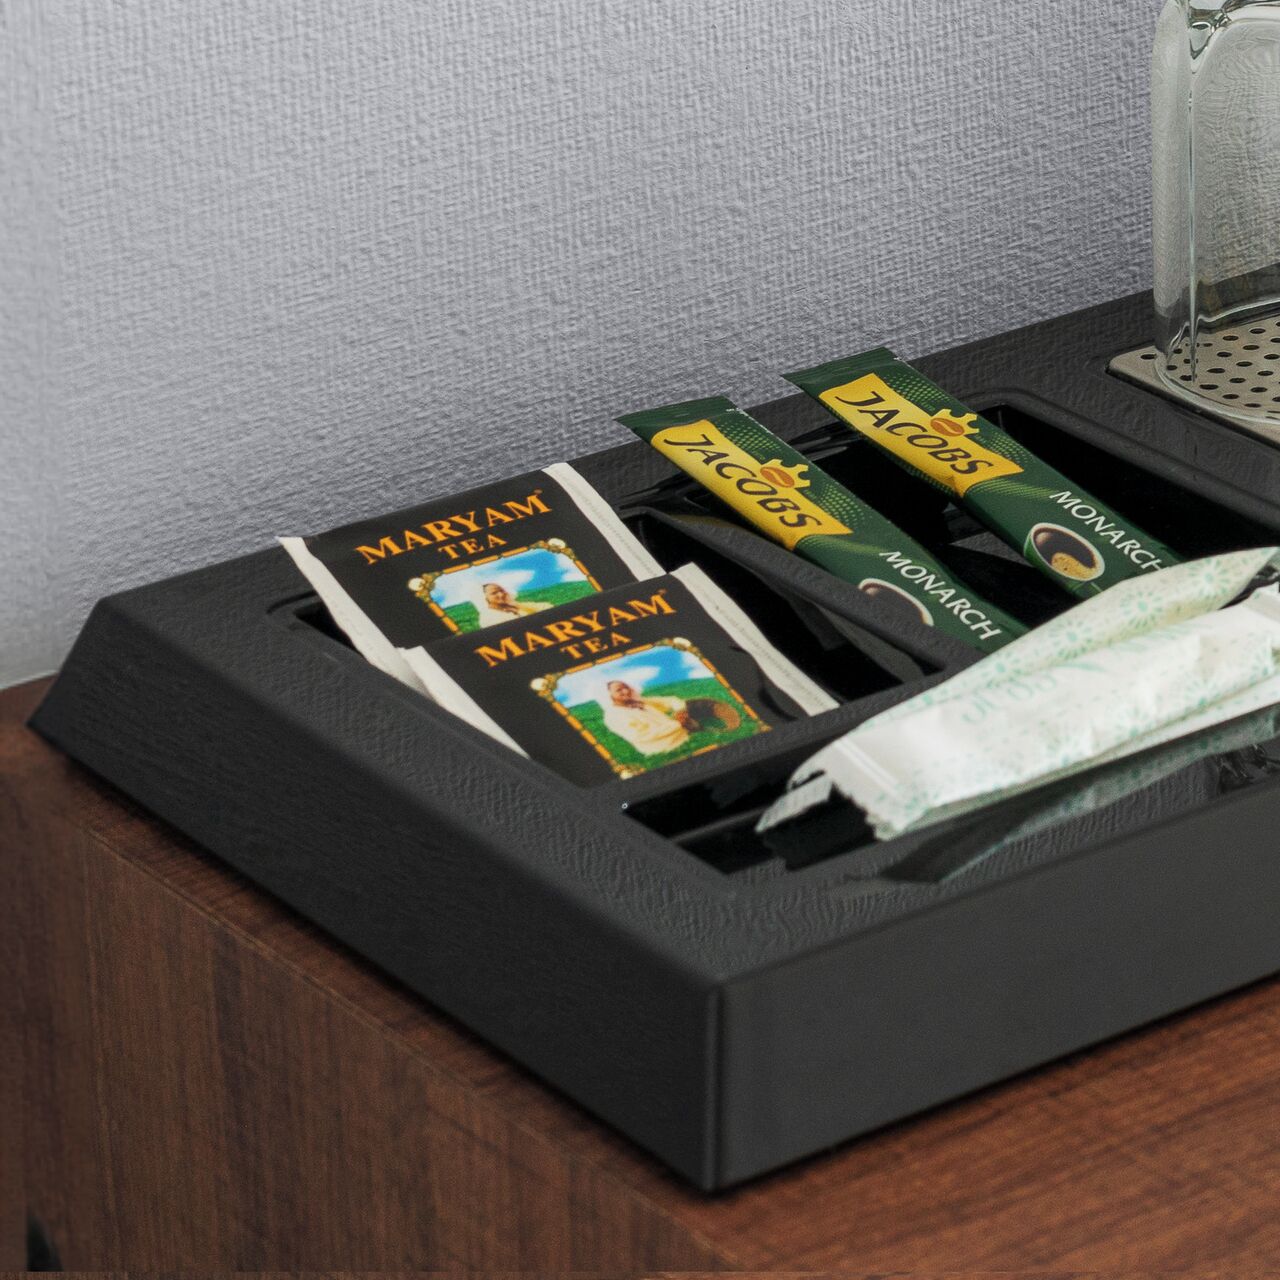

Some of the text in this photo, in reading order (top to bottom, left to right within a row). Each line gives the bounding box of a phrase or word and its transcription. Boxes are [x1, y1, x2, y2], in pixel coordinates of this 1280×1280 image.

[834, 389, 995, 476] JACOBS
[663, 432, 823, 533] JACOBS
[355, 494, 553, 566] MARYAM
[437, 533, 509, 562] TEA
[1047, 488, 1166, 572] MONARCH
[473, 594, 678, 669] MARYAM
[878, 550, 1003, 642] MONARCH
[560, 629, 633, 661] TEA
